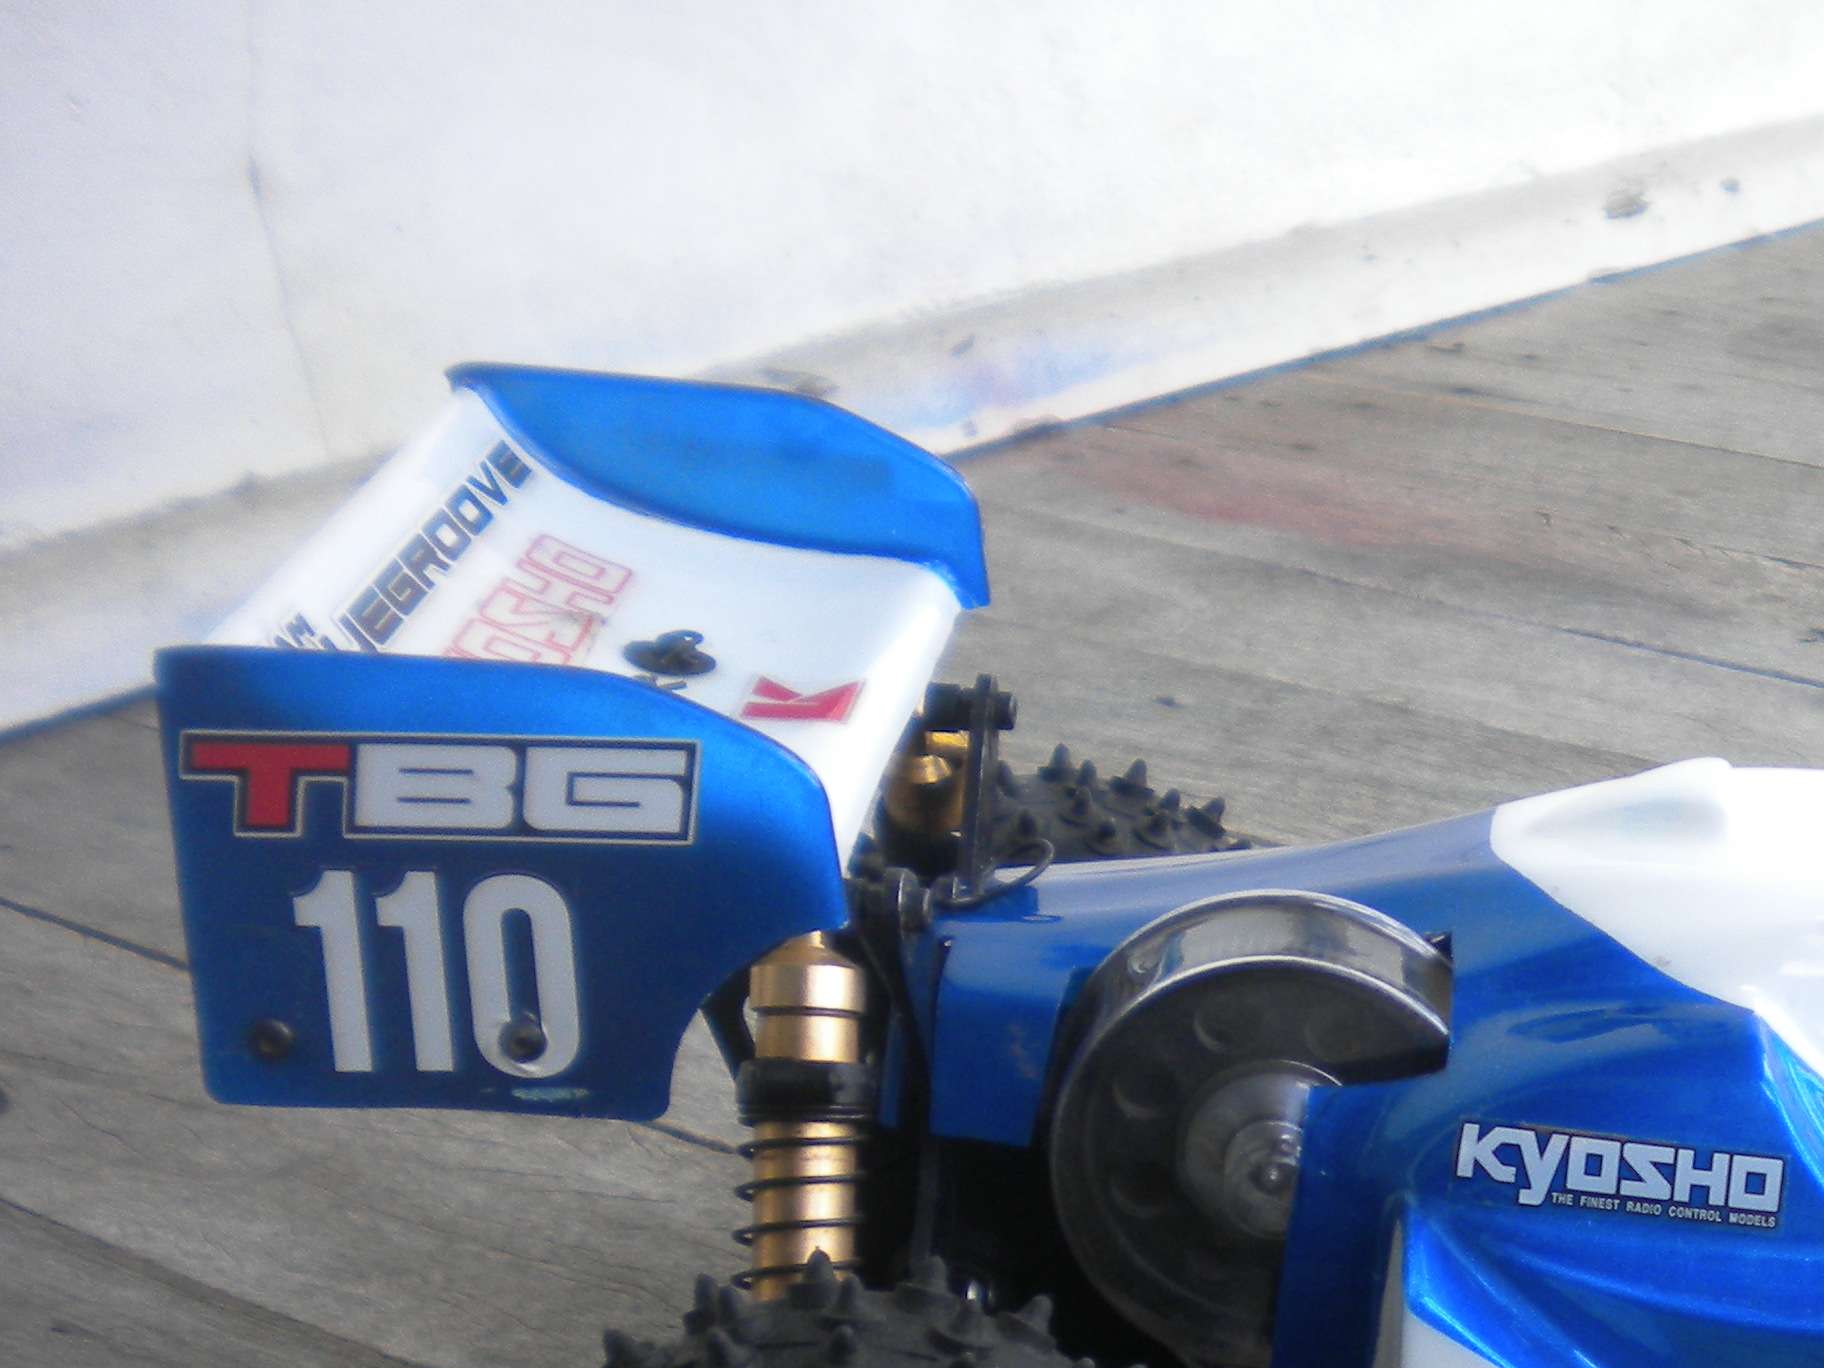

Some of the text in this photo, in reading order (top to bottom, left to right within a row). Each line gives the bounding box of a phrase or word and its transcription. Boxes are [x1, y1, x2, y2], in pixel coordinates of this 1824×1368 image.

[318, 439, 533, 653] UEGROOVE
[442, 534, 634, 666] OSHO
[187, 740, 692, 834] TBG
[293, 869, 582, 1080] 110
[1456, 1122, 1784, 1212] KYOSHO
[1551, 1192, 1776, 1228] THE FINEST RADIO CONTROL MODELS
